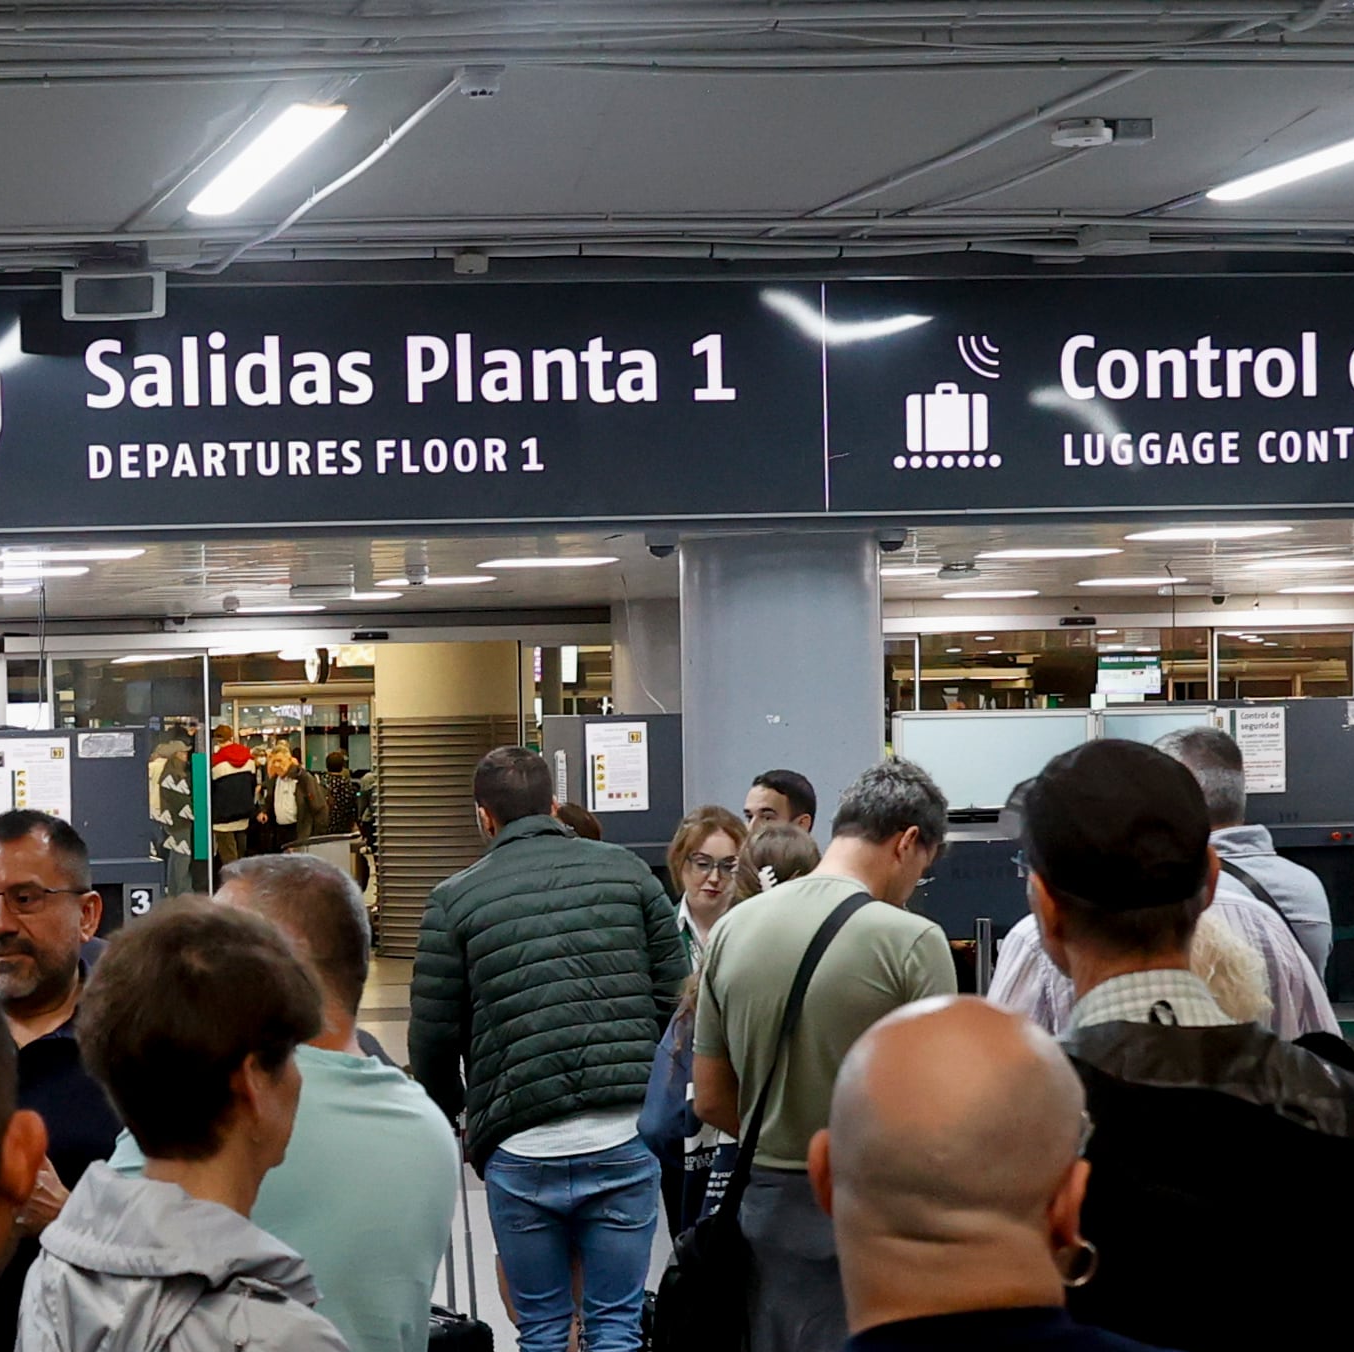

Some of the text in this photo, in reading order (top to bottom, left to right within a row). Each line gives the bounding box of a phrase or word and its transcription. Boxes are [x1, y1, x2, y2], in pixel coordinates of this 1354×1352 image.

[86, 332, 735, 408] Salidas Planta 1
[1055, 333, 1316, 401] Control
[89, 438, 543, 478] DEPARTURES FLOOR 1
[1063, 432, 1240, 466] LUGGAGE
[1240, 711, 1280, 720] Control de
[1241, 722, 1280, 731] seguridad
[131, 890, 151, 915] 3
